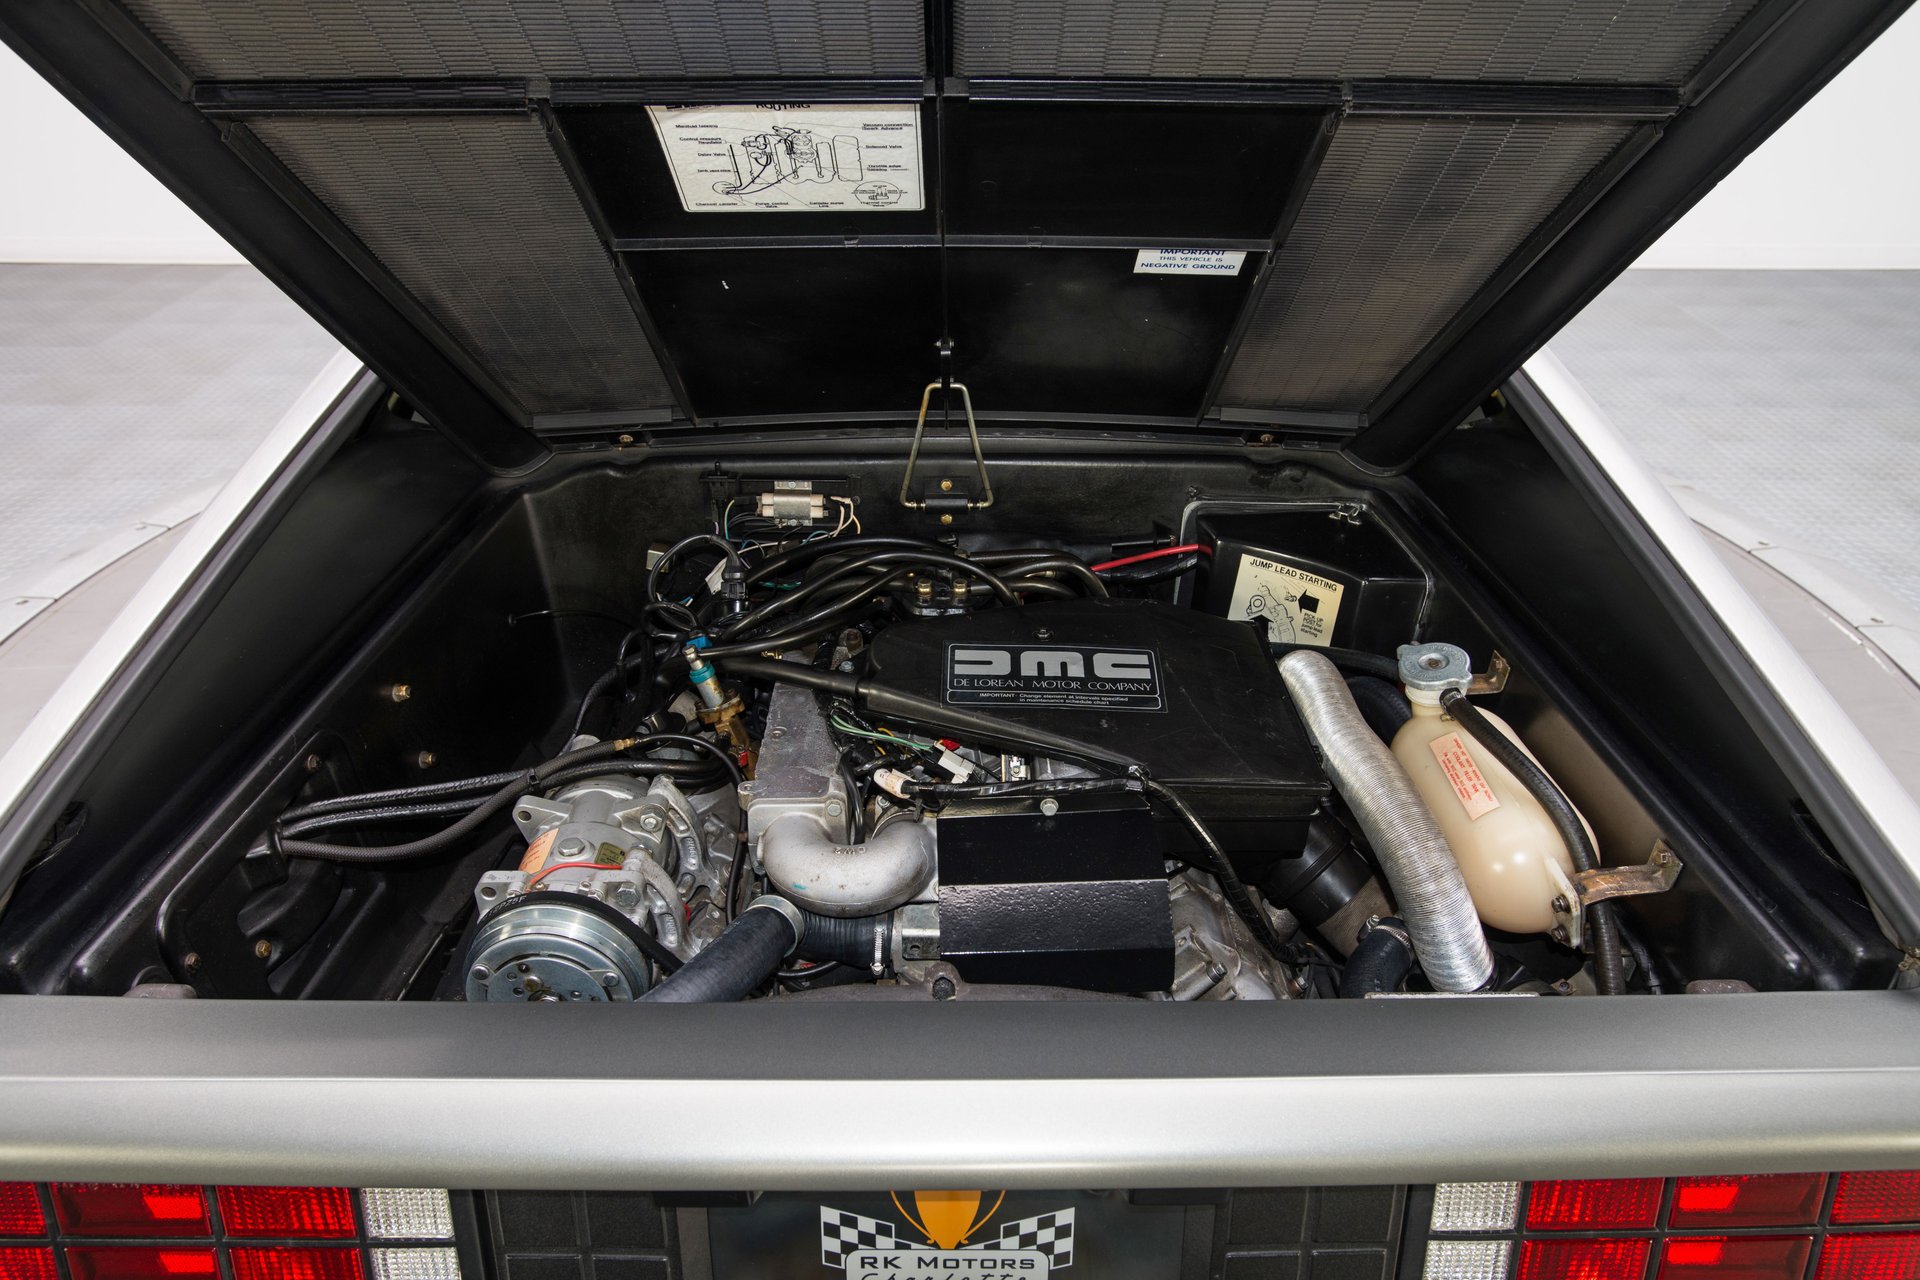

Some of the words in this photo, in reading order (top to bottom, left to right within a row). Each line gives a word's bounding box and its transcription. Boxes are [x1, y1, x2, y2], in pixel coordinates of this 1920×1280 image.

[1250, 558, 1273, 570] JUMP
[1274, 566, 1297, 578] LEAD
[1298, 572, 1337, 592] STARTING
[954, 678, 970, 687] DE
[974, 679, 1024, 687] LOREAN
[1032, 680, 1081, 689] MOTOR
[1088, 681, 1152, 691] COMPANY
[860, 1256, 902, 1269] RK
[917, 1256, 1035, 1269] MOTORS
